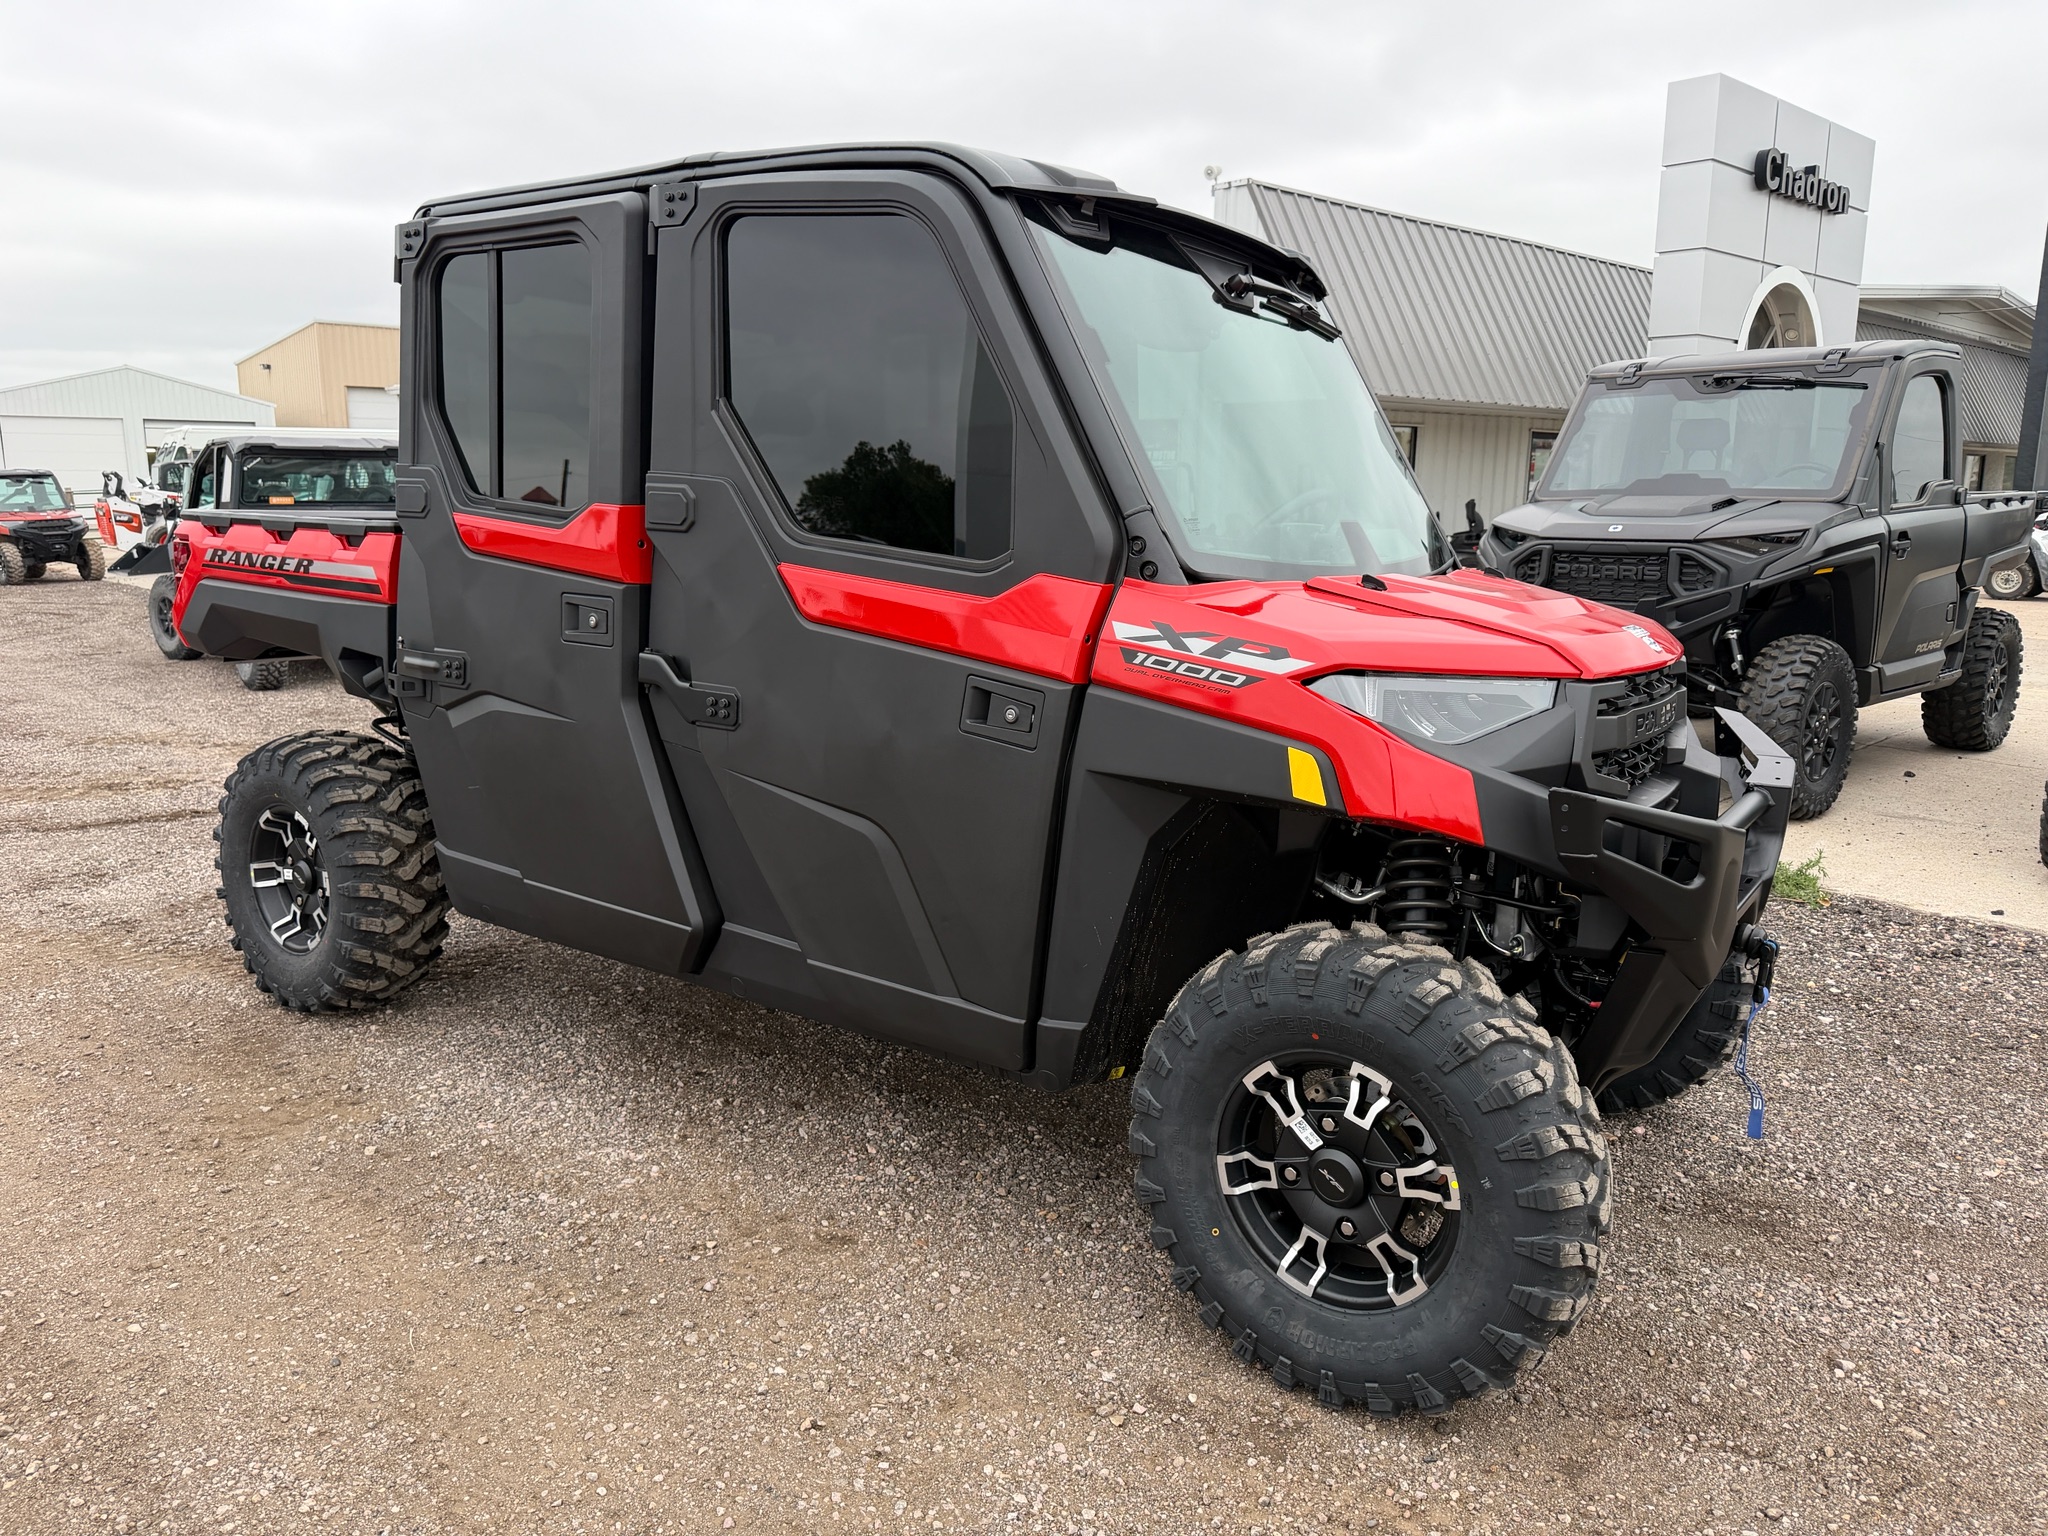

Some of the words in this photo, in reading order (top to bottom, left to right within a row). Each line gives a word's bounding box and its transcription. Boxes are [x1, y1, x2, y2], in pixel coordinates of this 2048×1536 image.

[1755, 148, 1850, 214] Chadron
[209, 548, 314, 574] RANGER
[1554, 563, 1661, 580] POLARIS
[1122, 620, 1291, 660] XP
[1914, 639, 1944, 654] POLARIS
[1124, 667, 1150, 677] DUAL
[1152, 673, 1206, 689] OVERHEAD
[1207, 686, 1231, 695] CAM
[1132, 652, 1247, 687] 1000
[1233, 1015, 1385, 1057] X-TERRAIN
[1318, 1168, 1345, 1193] XP
[1286, 1320, 1368, 1361] ARMOR
[1372, 1337, 1418, 1361] PRO
